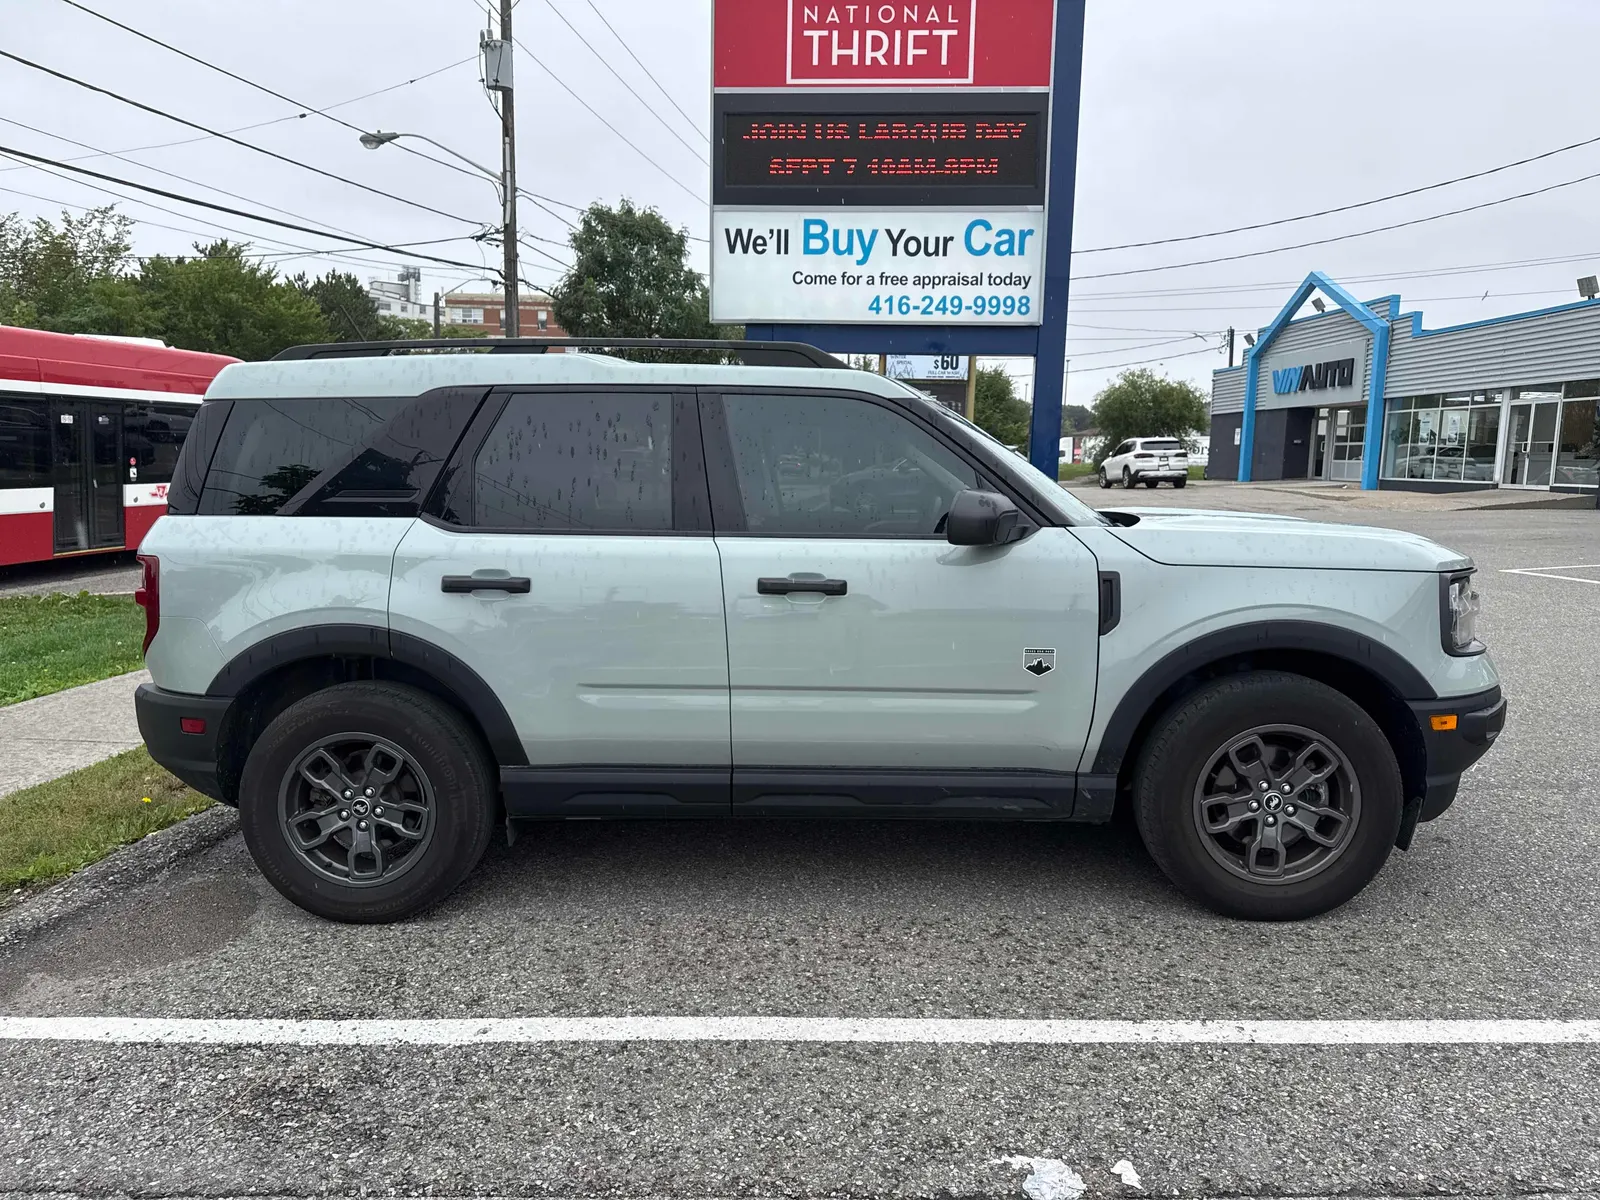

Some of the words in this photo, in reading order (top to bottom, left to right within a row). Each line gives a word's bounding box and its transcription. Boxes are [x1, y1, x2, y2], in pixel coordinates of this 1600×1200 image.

[804, 4, 959, 24] NATIONAL
[803, 29, 958, 66] THRIFT
[742, 123, 807, 140] JOIN
[814, 123, 851, 140] US
[975, 123, 1027, 140] DAY
[769, 158, 836, 174] SEPT
[842, 158, 857, 174] 7
[724, 227, 790, 256] We'll
[802, 218, 879, 266] Buy
[884, 228, 955, 258] Your
[963, 218, 1036, 257] Car
[792, 271, 837, 285] Come
[841, 271, 863, 286] for
[866, 275, 875, 286] a
[879, 271, 909, 286] free
[912, 271, 984, 290] appraisal
[987, 272, 1032, 290] today
[868, 294, 1031, 316] 416-249-9998
